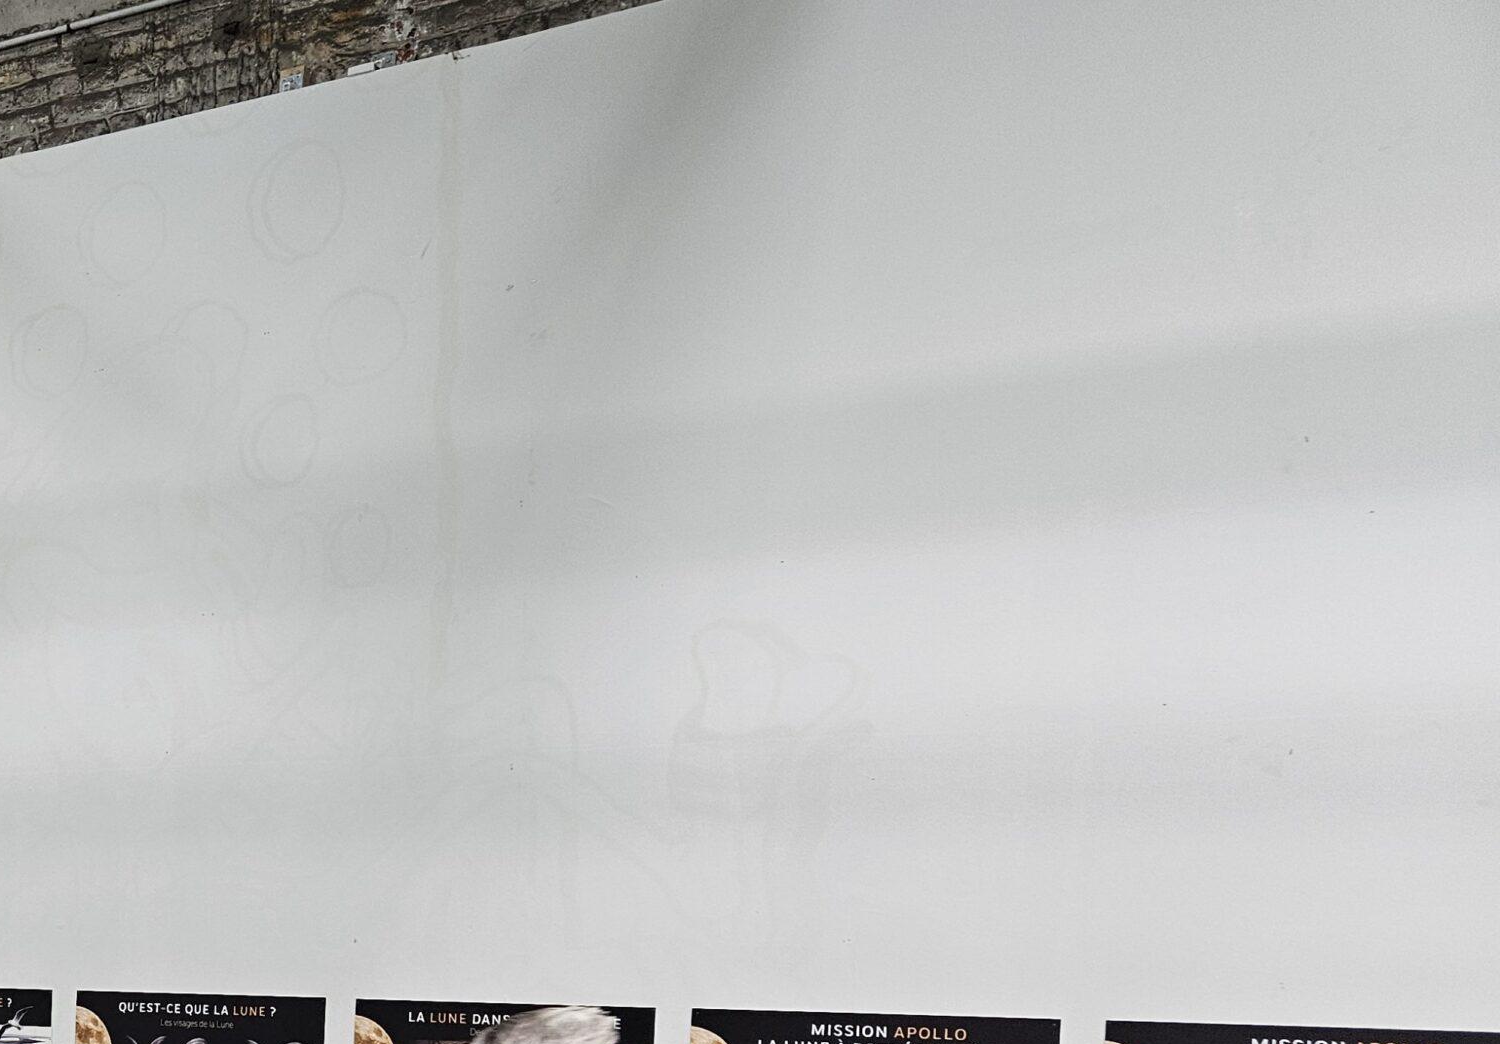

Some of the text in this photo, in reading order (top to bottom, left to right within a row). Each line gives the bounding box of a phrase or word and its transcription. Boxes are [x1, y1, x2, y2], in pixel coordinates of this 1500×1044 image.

[7, 997, 13, 1008] ?
[118, 1001, 277, 1018] QU'EST-CE QUE LA LUNE ?
[160, 1018, 173, 1027] Les
[173, 1020, 199, 1030] visages
[216, 1020, 234, 1029] Lune
[408, 1011, 425, 1023] LA
[429, 1012, 467, 1024] LUNE
[811, 1023, 967, 1041] MISSION APOLLO
